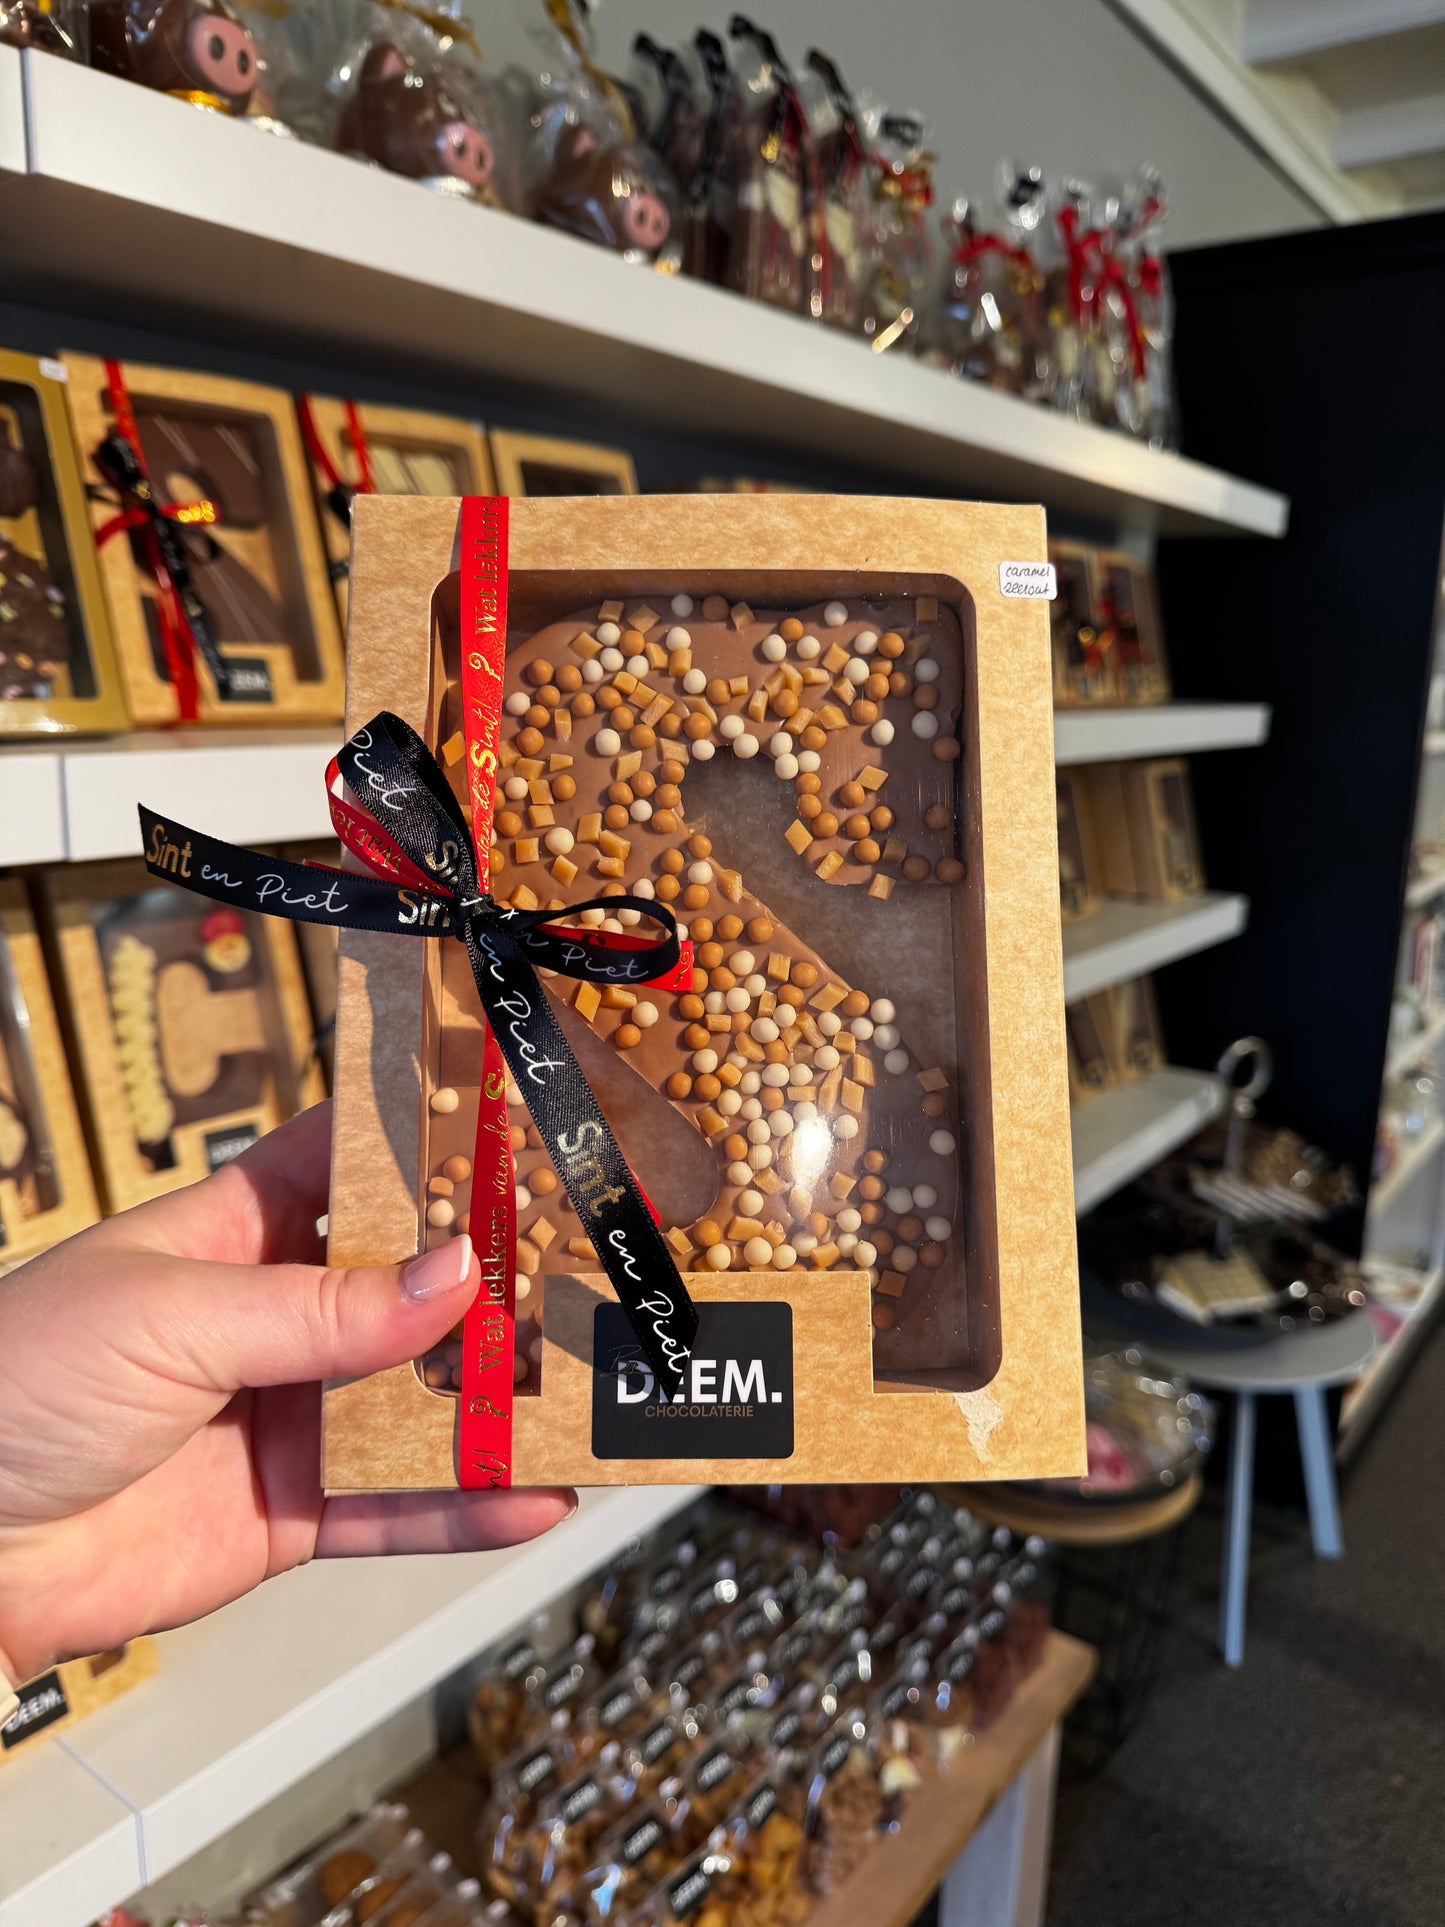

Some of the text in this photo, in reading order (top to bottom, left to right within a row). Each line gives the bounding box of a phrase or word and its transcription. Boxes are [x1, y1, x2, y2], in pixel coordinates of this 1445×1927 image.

[474, 497, 500, 635] Wat lekkers
[1005, 565, 1050, 578] caramel
[471, 782, 492, 811] de
[476, 812, 493, 860] van
[146, 823, 451, 928] Sint en Piet Sin
[560, 942, 650, 980] Piet
[491, 1147, 510, 1196] van
[493, 989, 566, 1086] Piet
[557, 1120, 627, 1218] Sint
[608, 1228, 642, 1282] en
[635, 1290, 692, 1373] Piet
[479, 1205, 508, 1307] lekkers
[478, 1313, 506, 1374] Wat
[644, 1404, 754, 1419] CHOCOLATERIE
